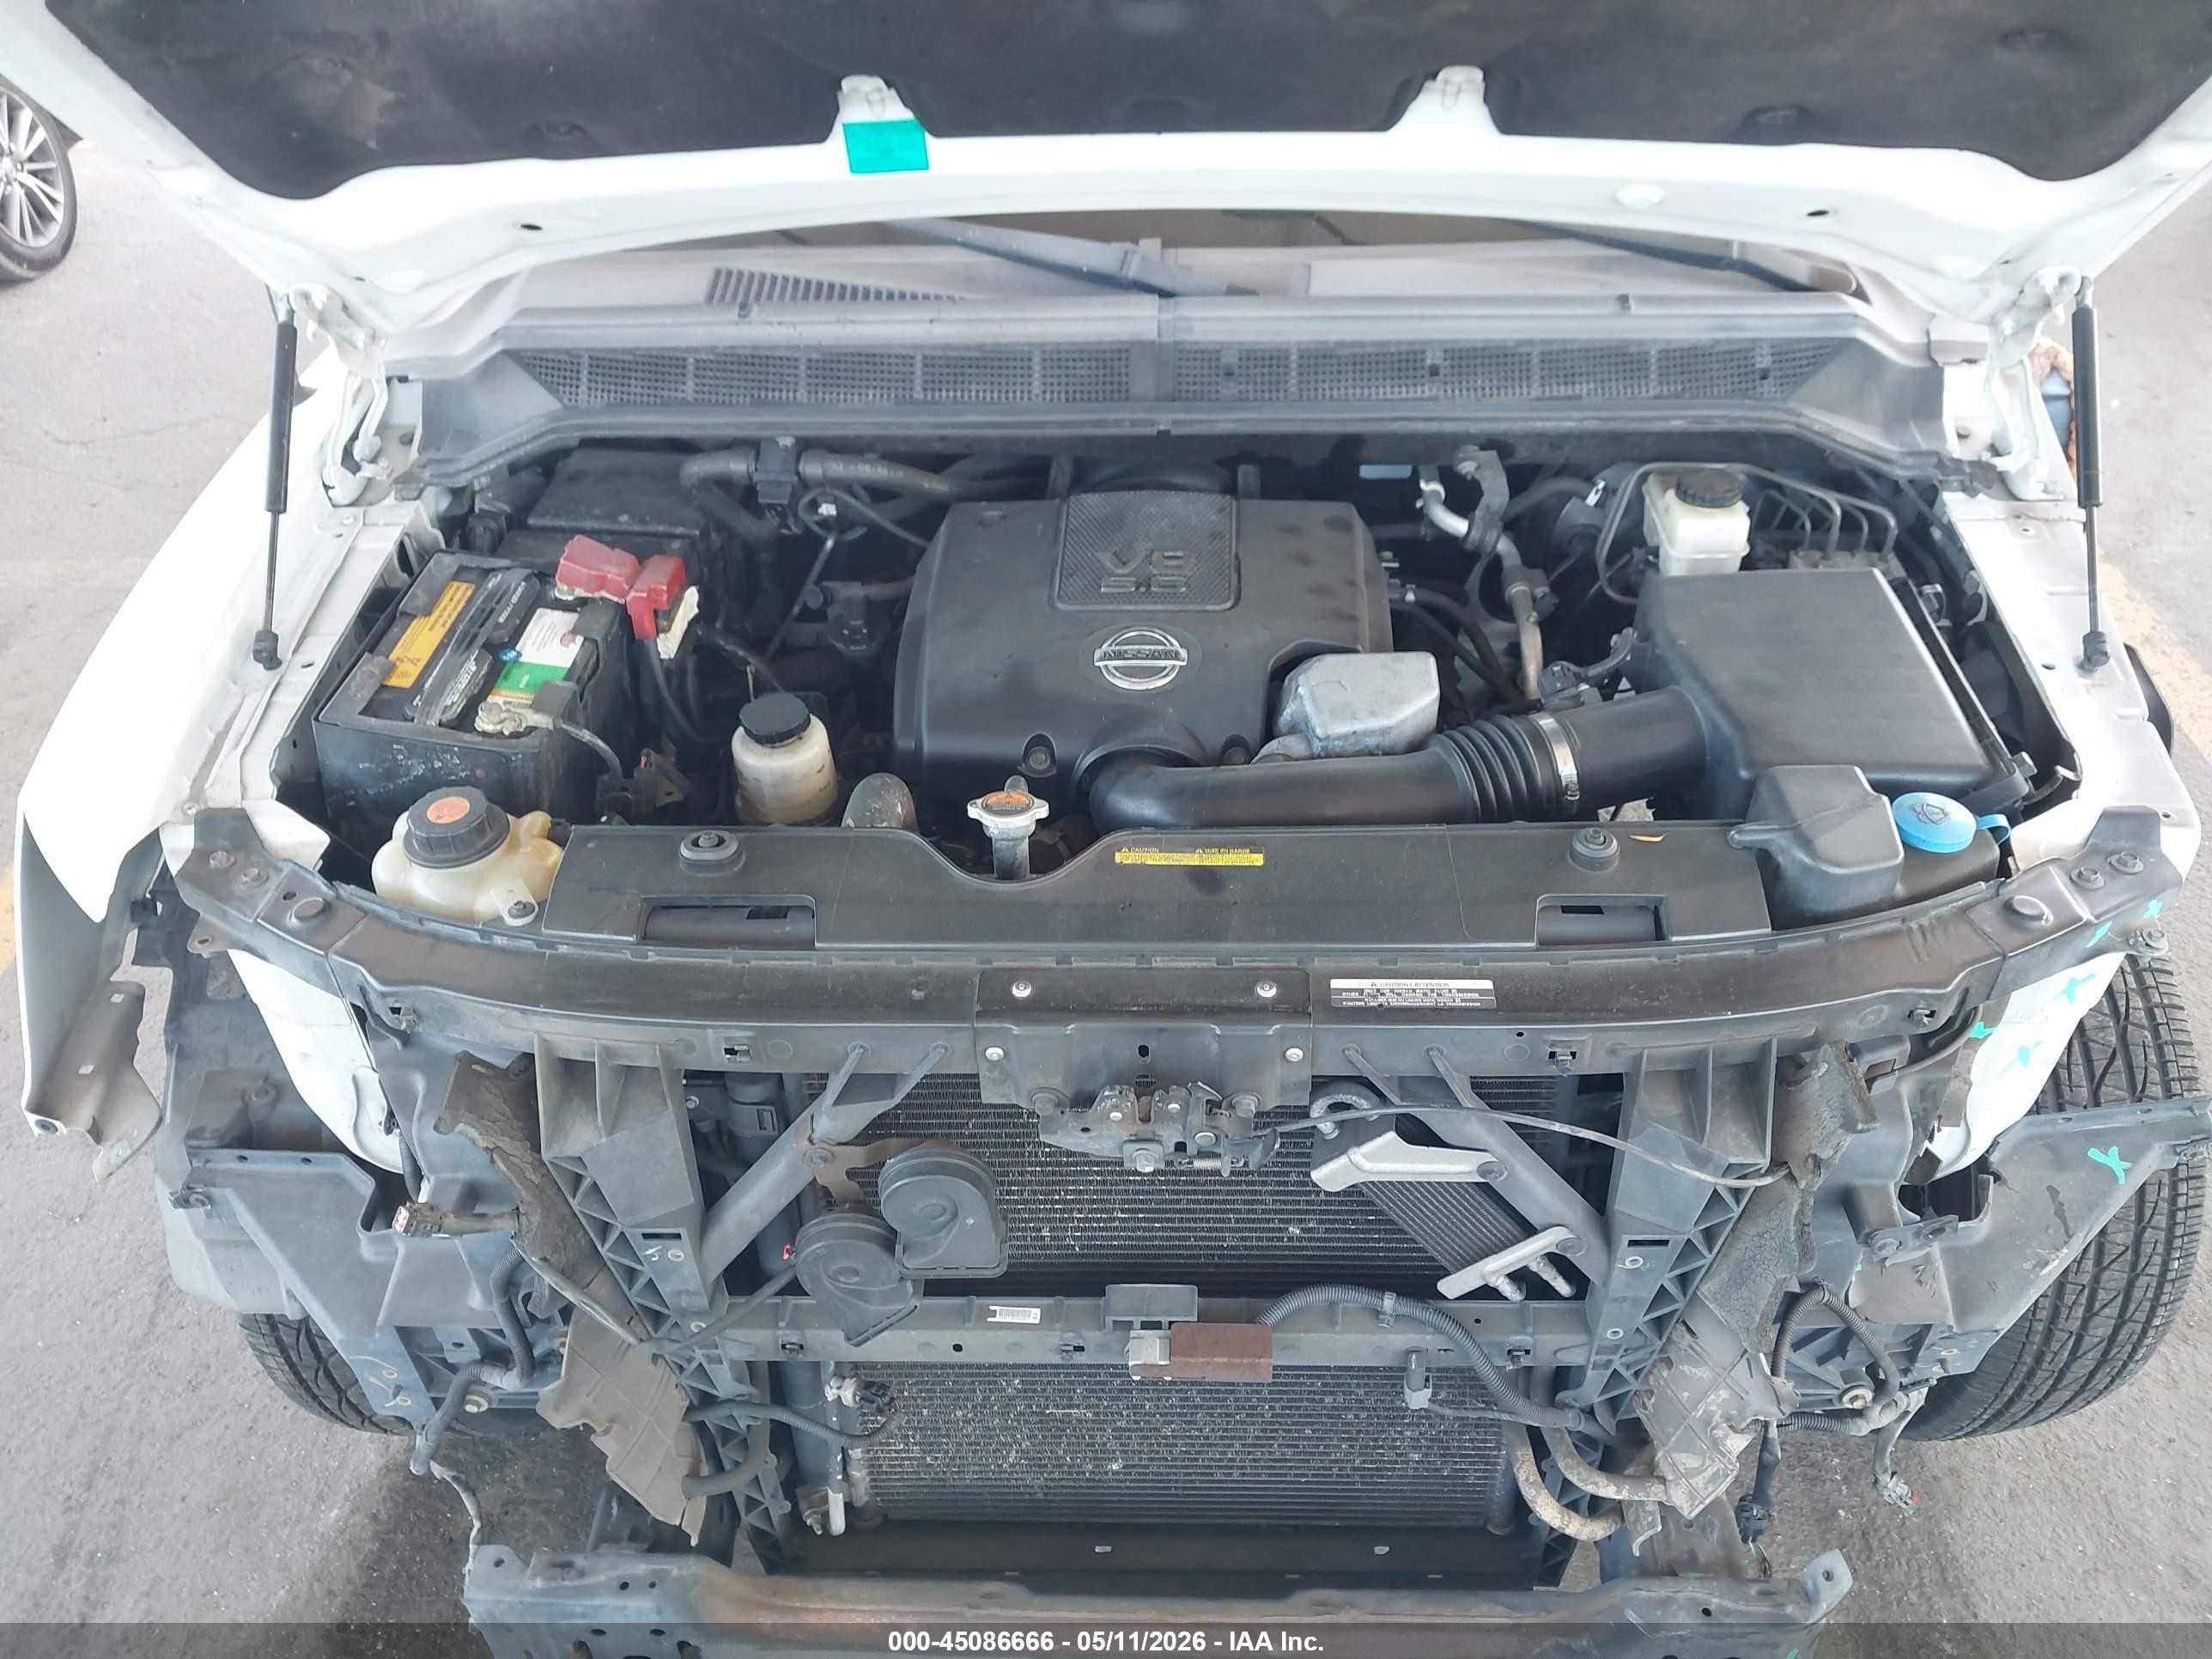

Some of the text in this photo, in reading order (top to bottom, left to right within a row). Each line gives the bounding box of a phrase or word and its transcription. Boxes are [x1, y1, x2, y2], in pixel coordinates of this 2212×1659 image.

[1099, 549, 1197, 574] V8
[1100, 576, 1188, 592] 5.6
[1103, 647, 1180, 660] NISSAN
